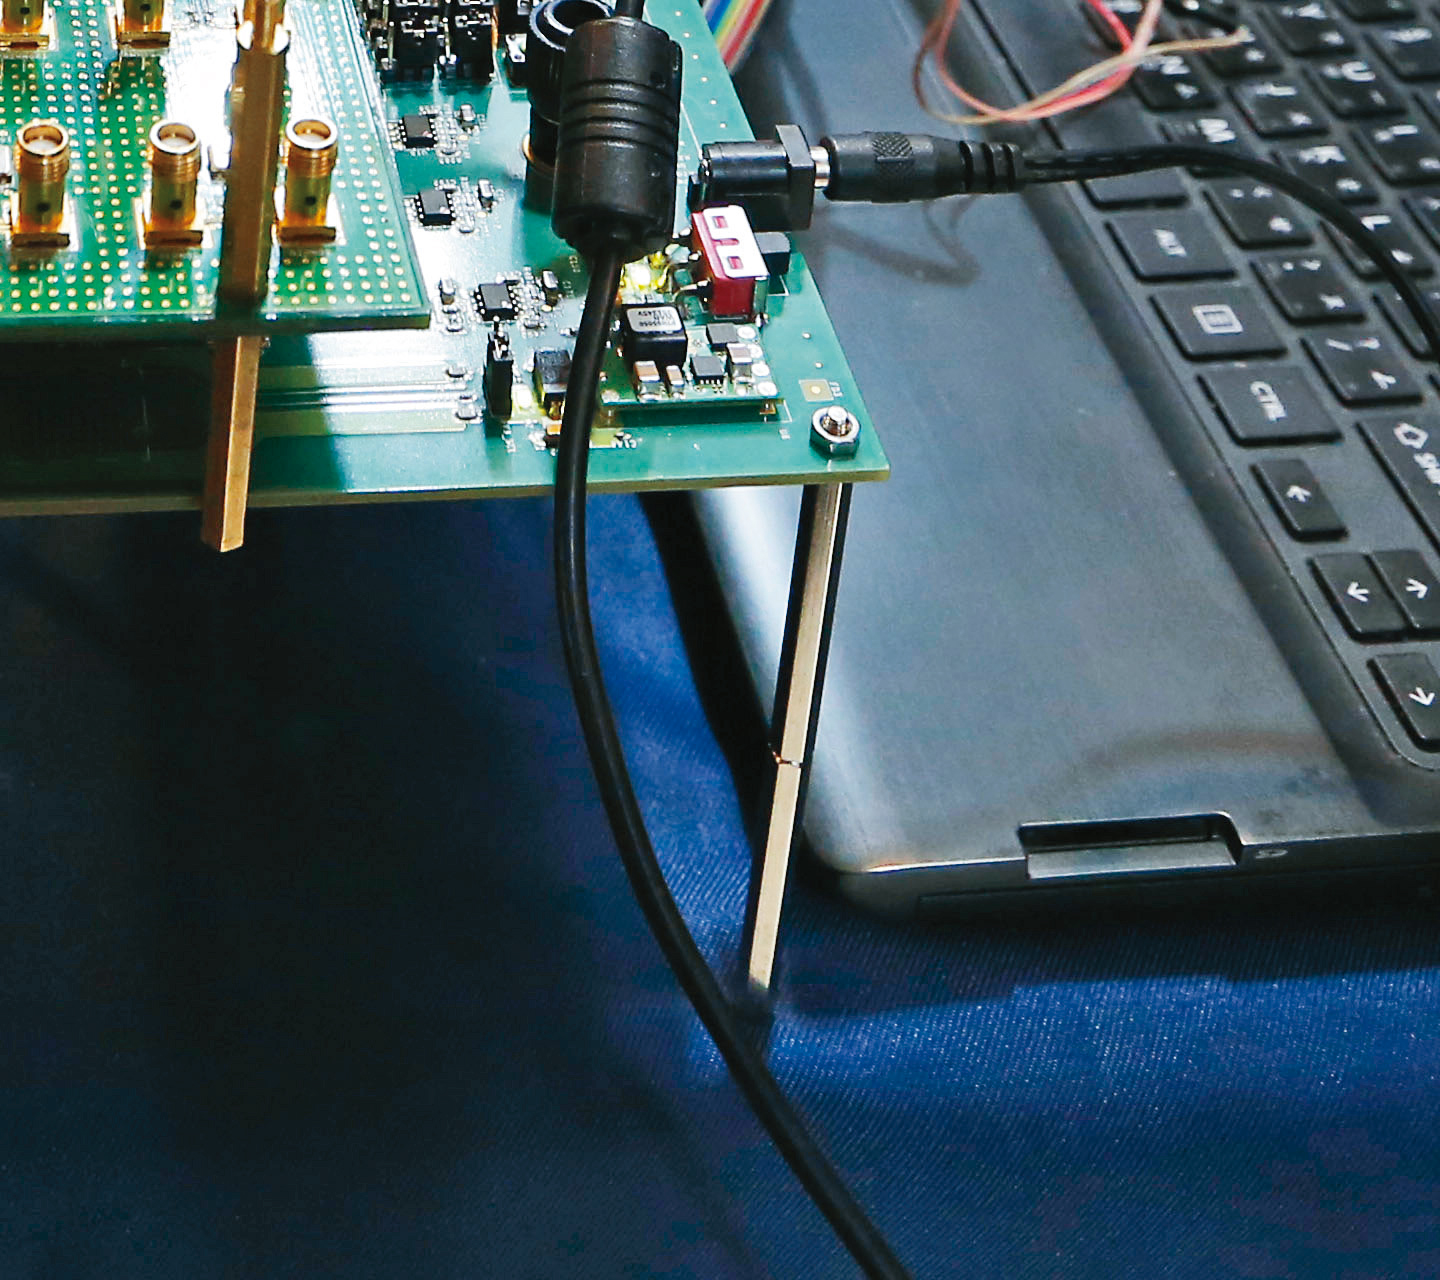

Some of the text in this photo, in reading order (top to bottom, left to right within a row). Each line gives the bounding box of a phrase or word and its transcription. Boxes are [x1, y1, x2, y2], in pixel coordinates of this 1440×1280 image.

[1341, 61, 1376, 82] U
[1197, 118, 1237, 144] M
[1249, 380, 1288, 423] CTRL
